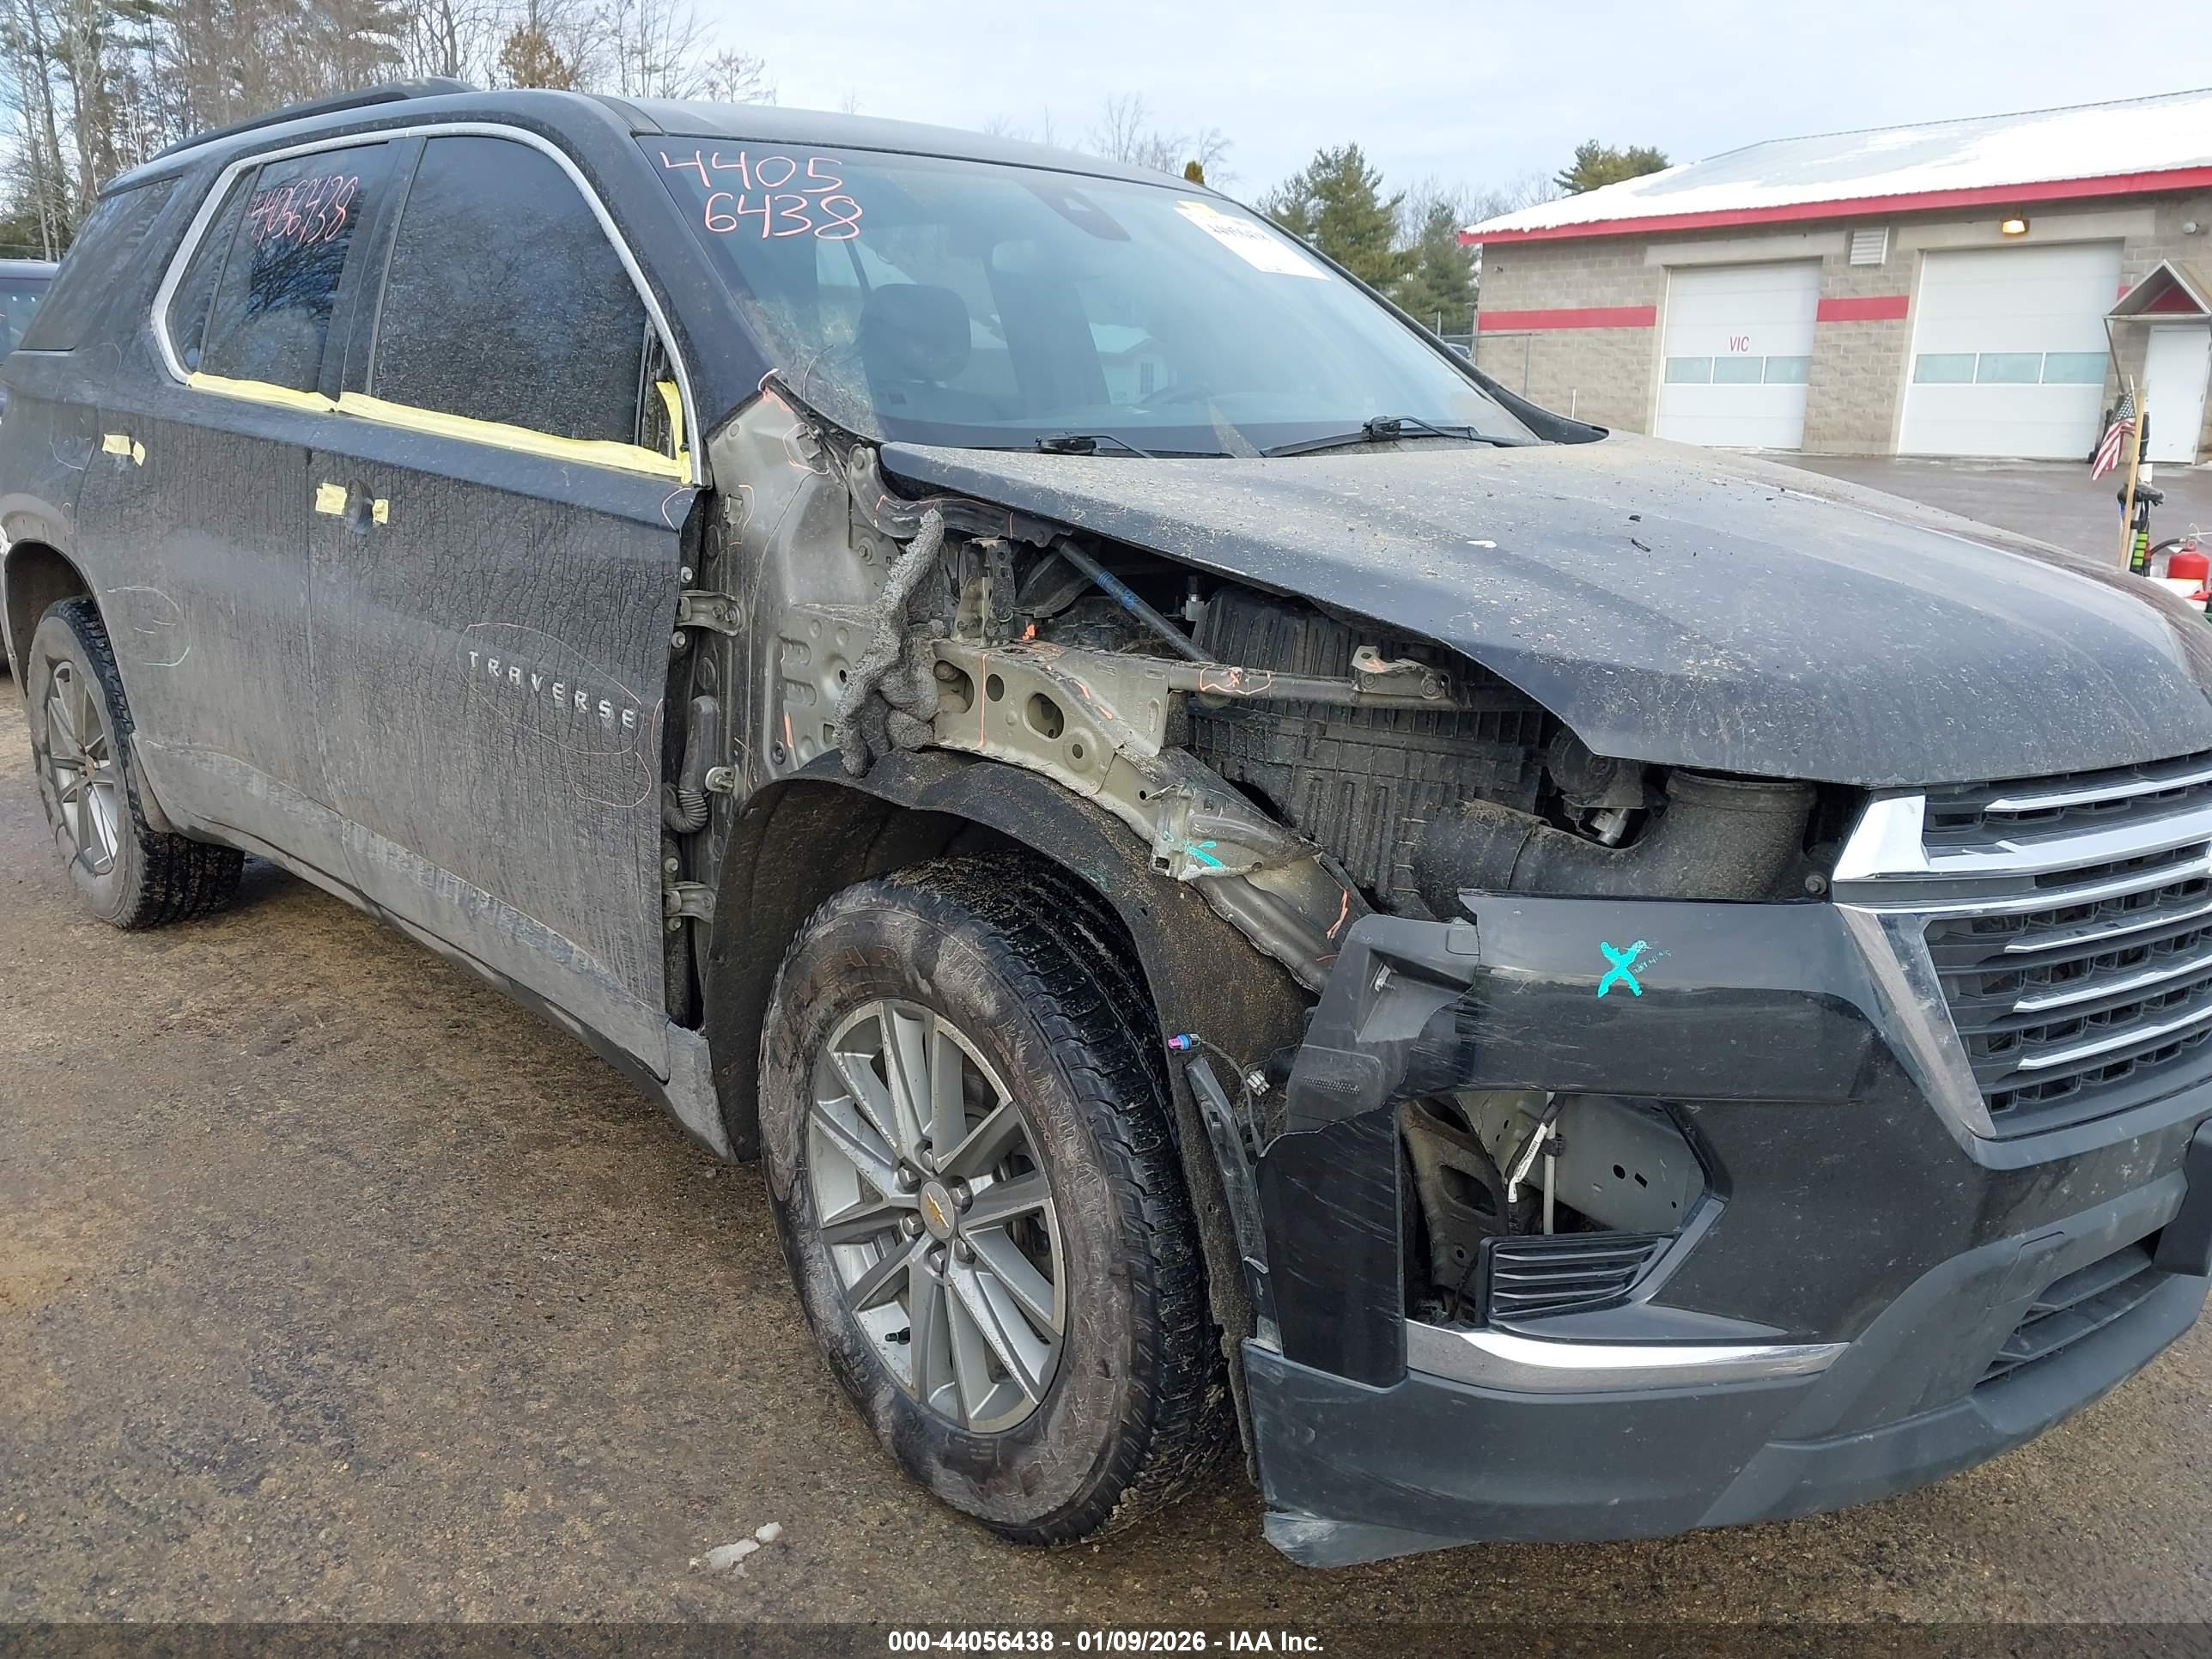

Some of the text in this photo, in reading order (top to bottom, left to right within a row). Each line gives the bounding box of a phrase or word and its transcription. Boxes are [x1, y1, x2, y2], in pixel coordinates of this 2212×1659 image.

[659, 149, 843, 193] 4405
[704, 192, 863, 240] 6438
[1729, 336, 1749, 351] VIC
[469, 651, 634, 729] TRAVERSE
